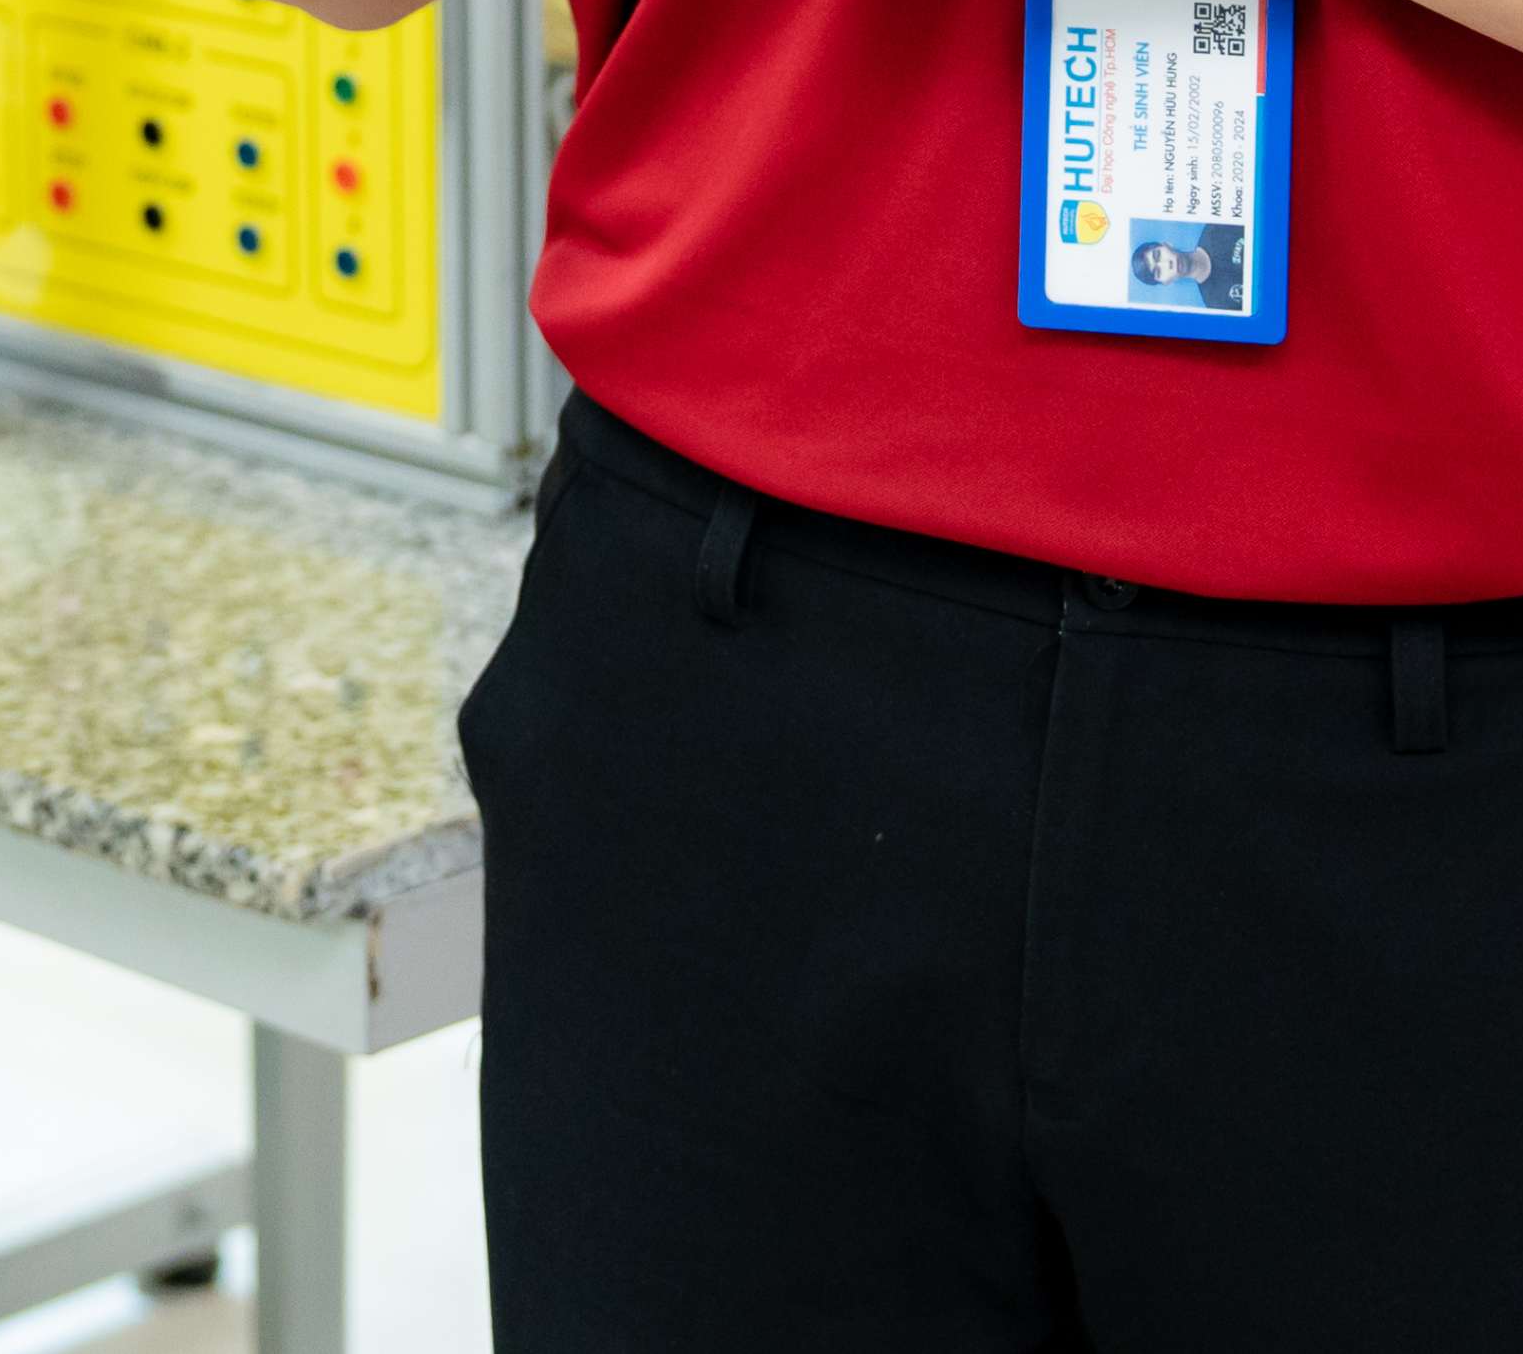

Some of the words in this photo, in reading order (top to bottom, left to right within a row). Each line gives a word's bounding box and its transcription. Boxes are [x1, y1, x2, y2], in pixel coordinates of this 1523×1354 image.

[1132, 41, 1150, 78] VIÊN
[1064, 26, 1098, 192] HUTECH
[1134, 83, 1149, 121] SINH
[1187, 75, 1201, 151] 15/02/2002
[1233, 110, 1245, 141] 2024
[1232, 151, 1245, 183] 2020
[1210, 180, 1223, 217] MSSV:
